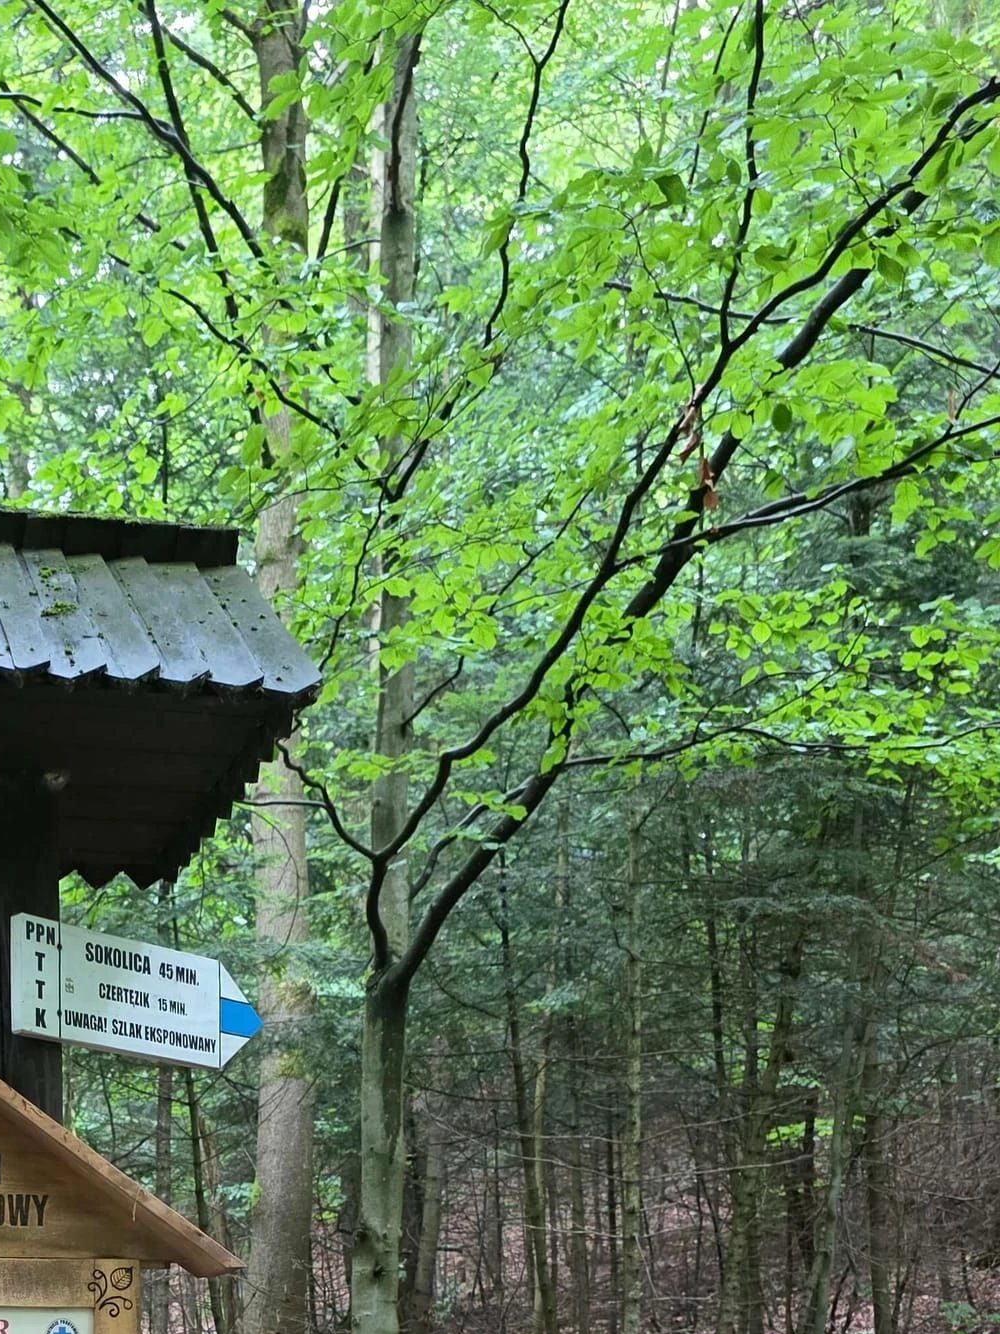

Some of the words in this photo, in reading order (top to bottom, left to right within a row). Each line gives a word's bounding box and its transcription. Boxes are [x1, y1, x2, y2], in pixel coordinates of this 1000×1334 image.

[26, 920, 55, 946] PPN
[85, 942, 151, 975] SOKOLICA
[159, 962, 173, 980] 45
[176, 964, 199, 986] MIN.
[99, 983, 150, 1008] CZERTĘZIK
[158, 998, 168, 1012] 15
[169, 1000, 188, 1016] MIN.
[64, 1009, 107, 1033] UWAGA!
[112, 1019, 142, 1040] SZLAK
[145, 1027, 216, 1054] EKSPONOWANY
